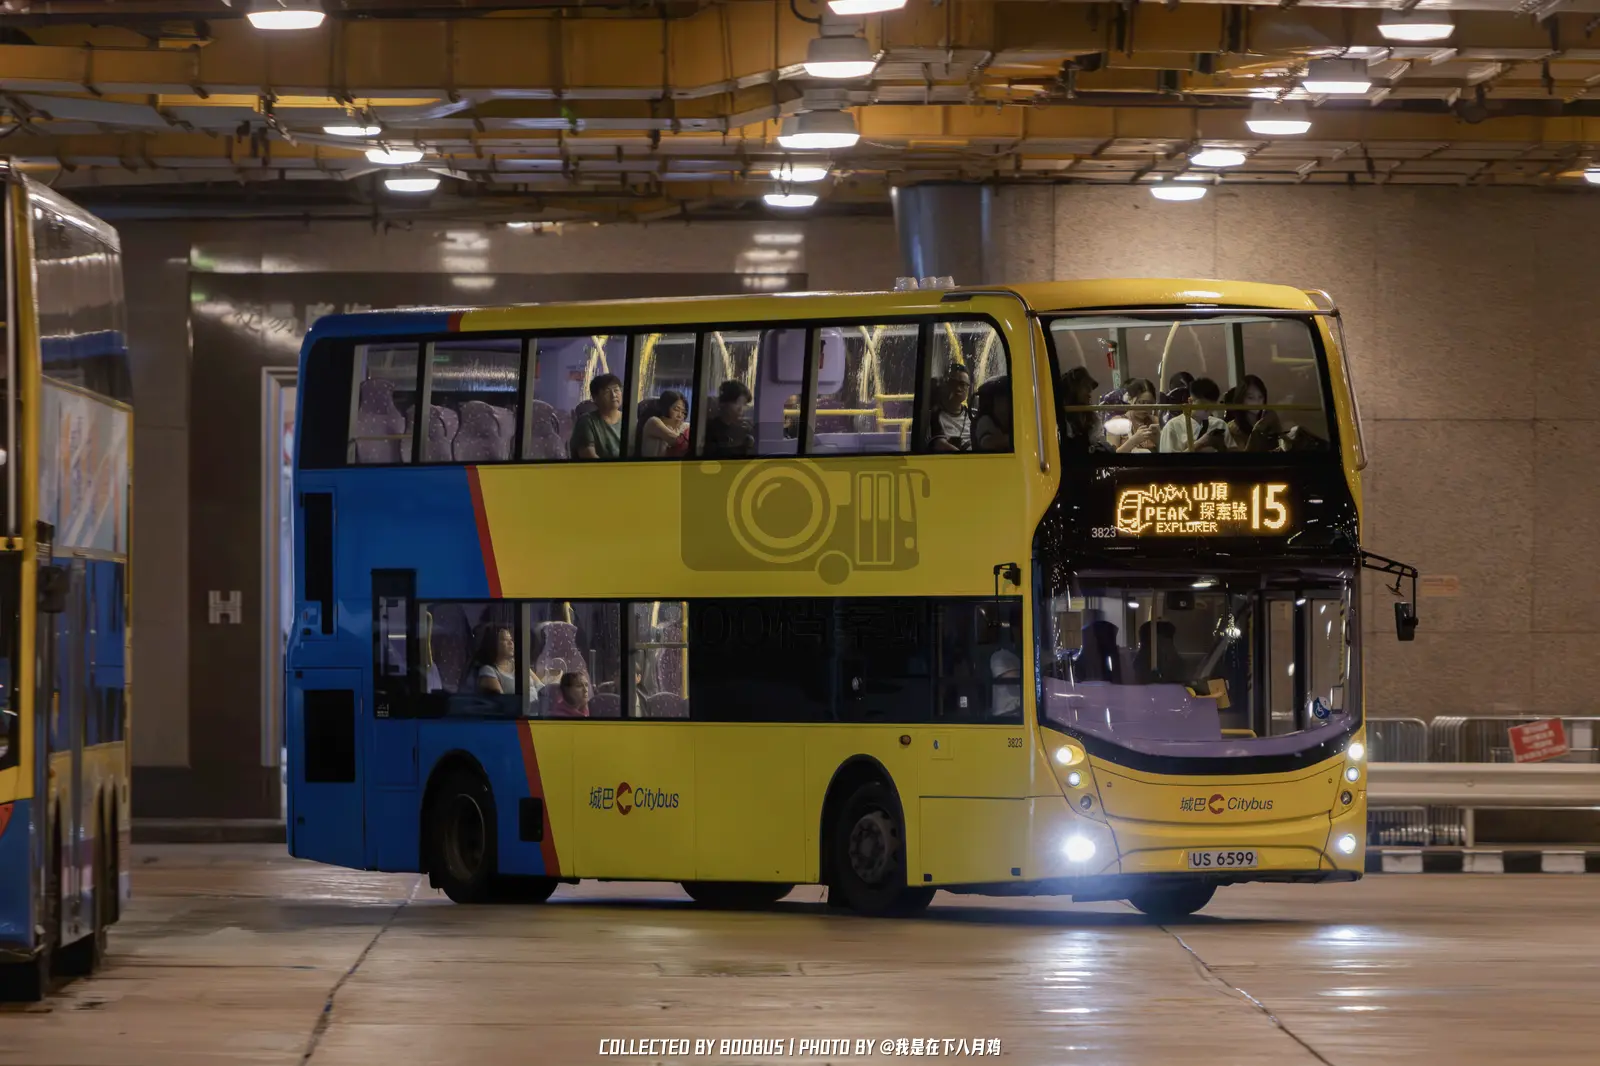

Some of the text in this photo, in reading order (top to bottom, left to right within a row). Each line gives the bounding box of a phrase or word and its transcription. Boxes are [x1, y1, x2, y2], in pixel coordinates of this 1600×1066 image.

[1193, 483, 1228, 501] 山頂
[1145, 506, 1190, 521] PEAK
[1200, 502, 1248, 520] 探索號
[1252, 484, 1287, 529] 15
[1091, 527, 1117, 538] 3823
[1156, 522, 1218, 533] EXPLORER
[1007, 737, 1023, 748] 3823
[589, 786, 679, 811] 城巴 Citybus
[1180, 797, 1274, 811] 城巴 Citybus
[1192, 851, 1254, 866] US 6599
